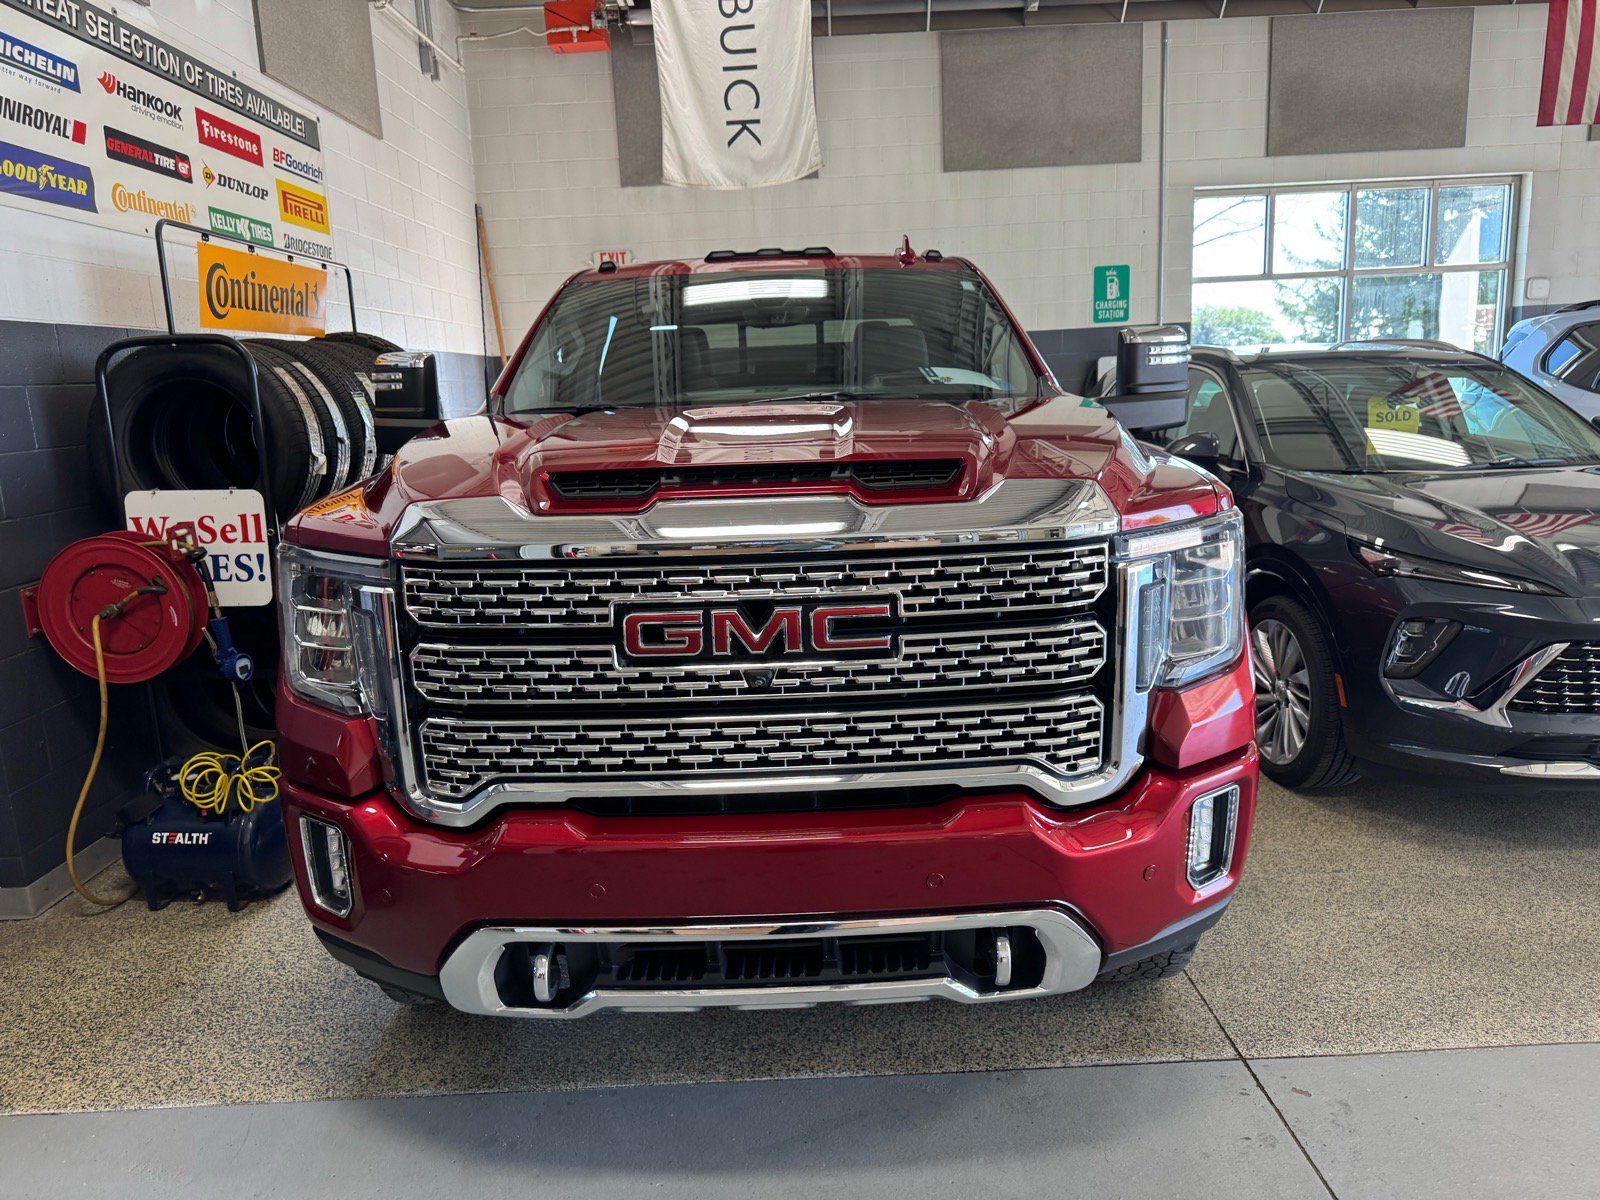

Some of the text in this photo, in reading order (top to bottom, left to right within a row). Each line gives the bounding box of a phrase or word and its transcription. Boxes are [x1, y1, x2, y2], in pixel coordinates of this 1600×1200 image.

[19, 73, 32, 84] way
[34, 78, 61, 94] forward
[85, 9, 181, 78] SELECTION
[184, 59, 205, 87] OF
[206, 72, 243, 107] TIRES
[246, 92, 306, 138] AVAILABLE!
[717, 0, 762, 148] BUICK
[131, 104, 184, 131] driving emotion
[201, 119, 259, 156] Firestone
[273, 147, 323, 181] BFGoodrich
[217, 173, 269, 200] DUNLOP
[111, 182, 191, 224] Continental
[281, 189, 325, 225] PIRELLI
[210, 211, 236, 233] KELLY
[250, 222, 272, 242] TIRES
[283, 233, 333, 260] BRIDGESTONE
[206, 262, 309, 320] Continental
[1095, 300, 1128, 310] CHARGING
[1098, 309, 1125, 320] STATION
[1375, 410, 1412, 423] SOLD
[197, 513, 266, 545] Sell
[624, 604, 891, 657] GMC
[151, 831, 209, 845] STEALTH
